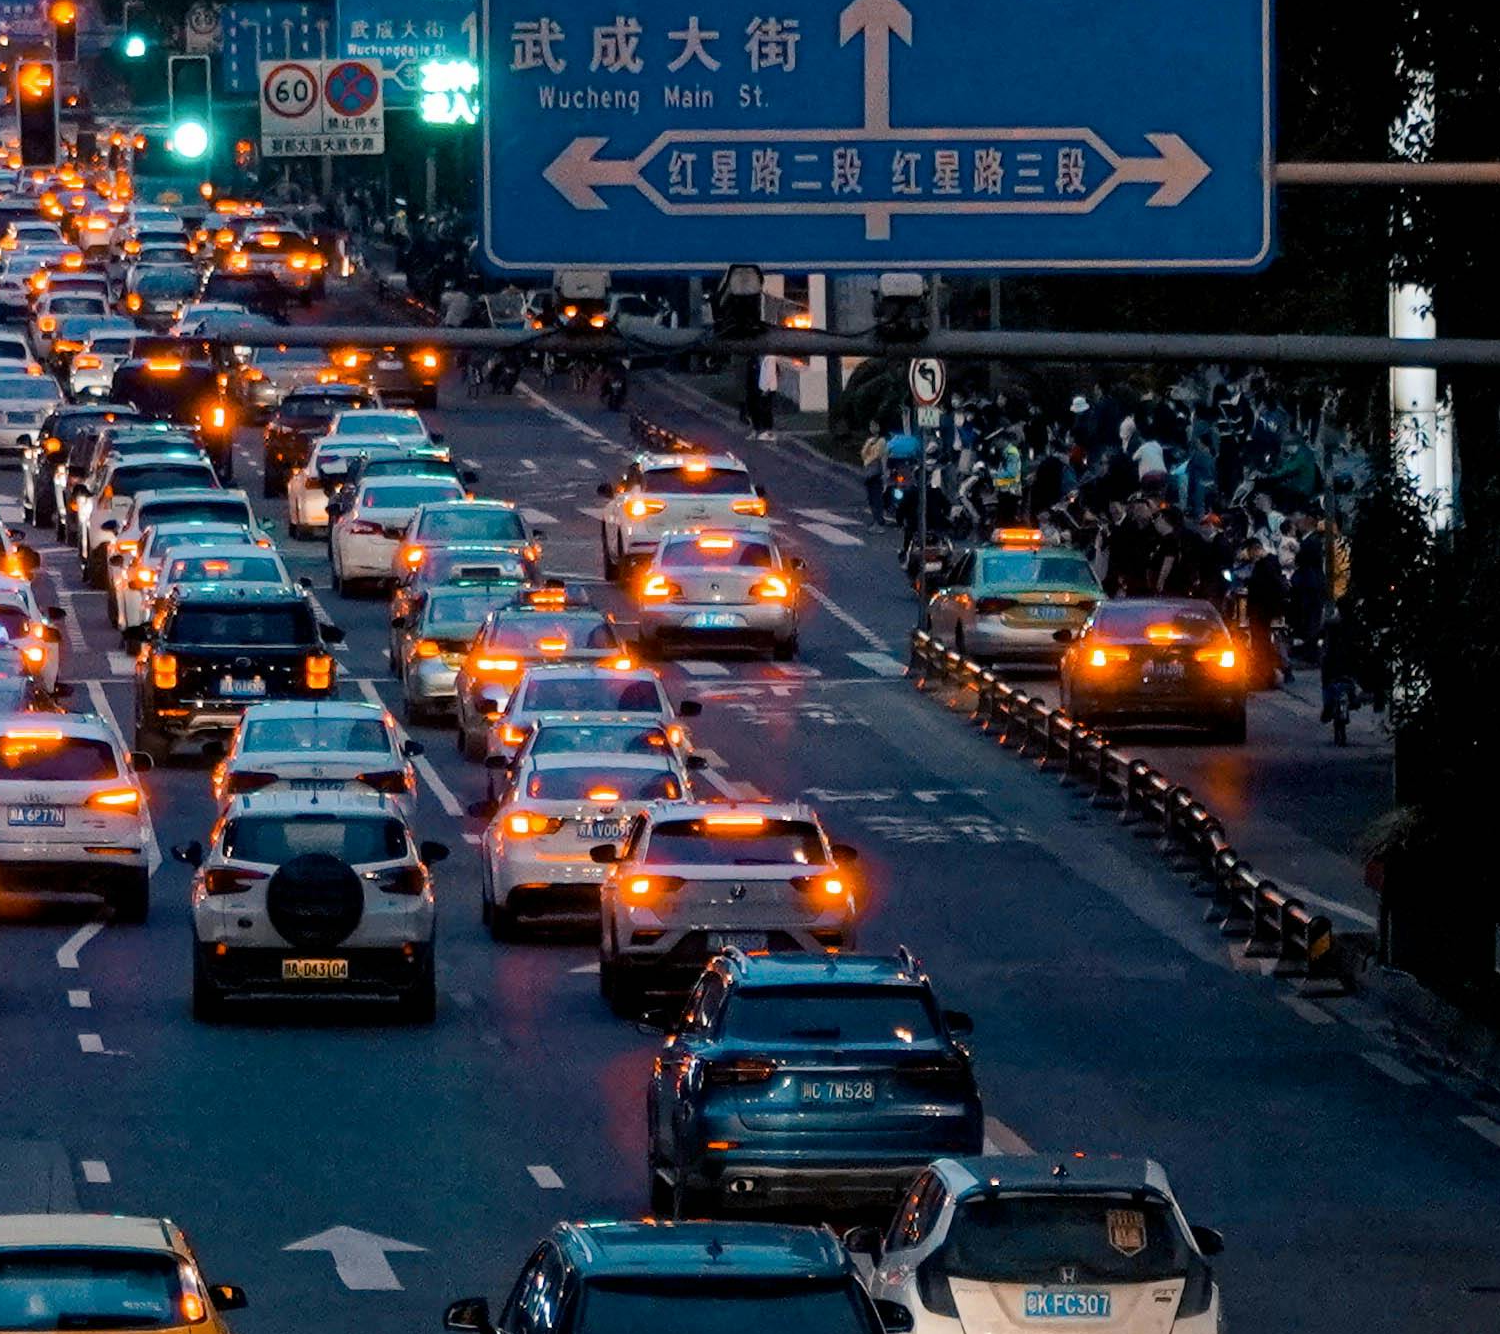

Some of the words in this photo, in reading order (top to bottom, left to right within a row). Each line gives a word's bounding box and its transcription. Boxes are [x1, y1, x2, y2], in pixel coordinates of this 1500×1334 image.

[510, 17, 801, 73] 武成大街
[275, 79, 308, 103] 60
[538, 85, 640, 114] Wucheng
[663, 85, 714, 108] Main
[739, 84, 770, 108] St.
[668, 148, 863, 195] 红星路二段
[891, 148, 1087, 195] 红星路三段
[825, 1082, 873, 1099] 7W528
